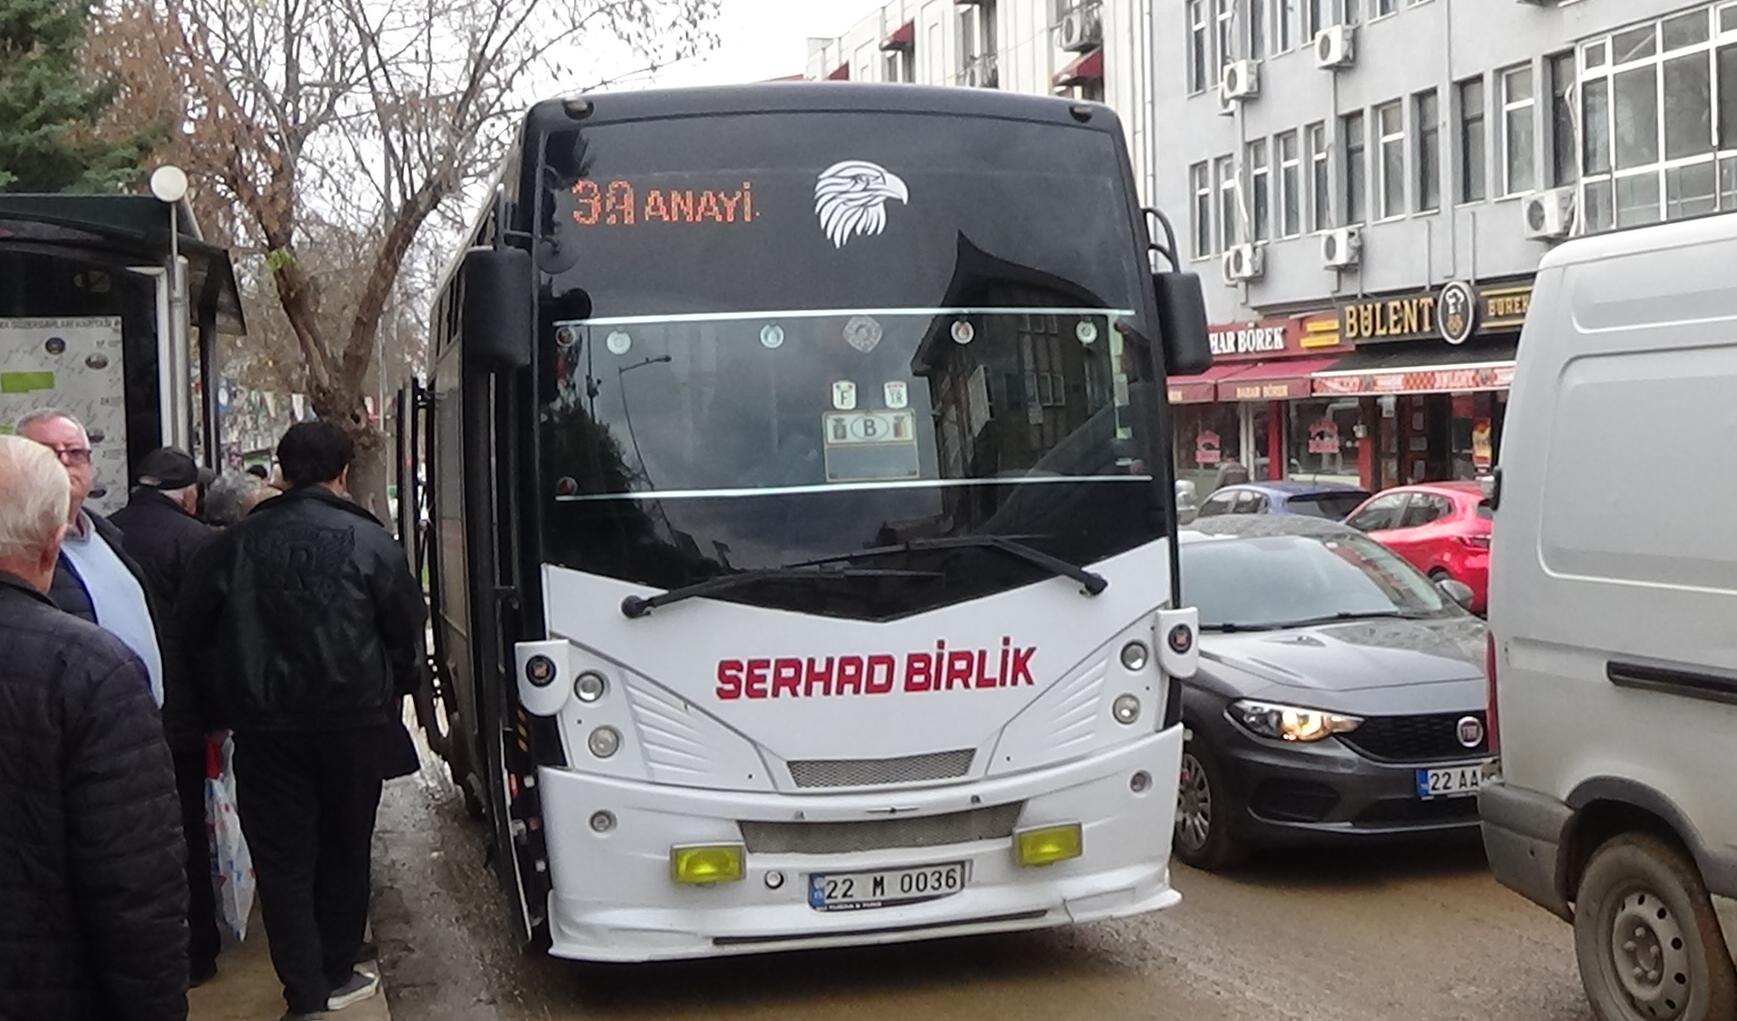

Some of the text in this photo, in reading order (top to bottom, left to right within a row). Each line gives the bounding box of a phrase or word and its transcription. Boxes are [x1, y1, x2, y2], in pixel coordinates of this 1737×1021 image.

[571, 179, 635, 225] 3A
[1237, 322, 1285, 353] BÖREK
[840, 391, 849, 405] F
[863, 419, 877, 437] B
[715, 636, 1037, 700] SERHAD BİRLİK
[1430, 770, 1479, 791] 22 AA
[825, 868, 957, 900] 22 M 0036
